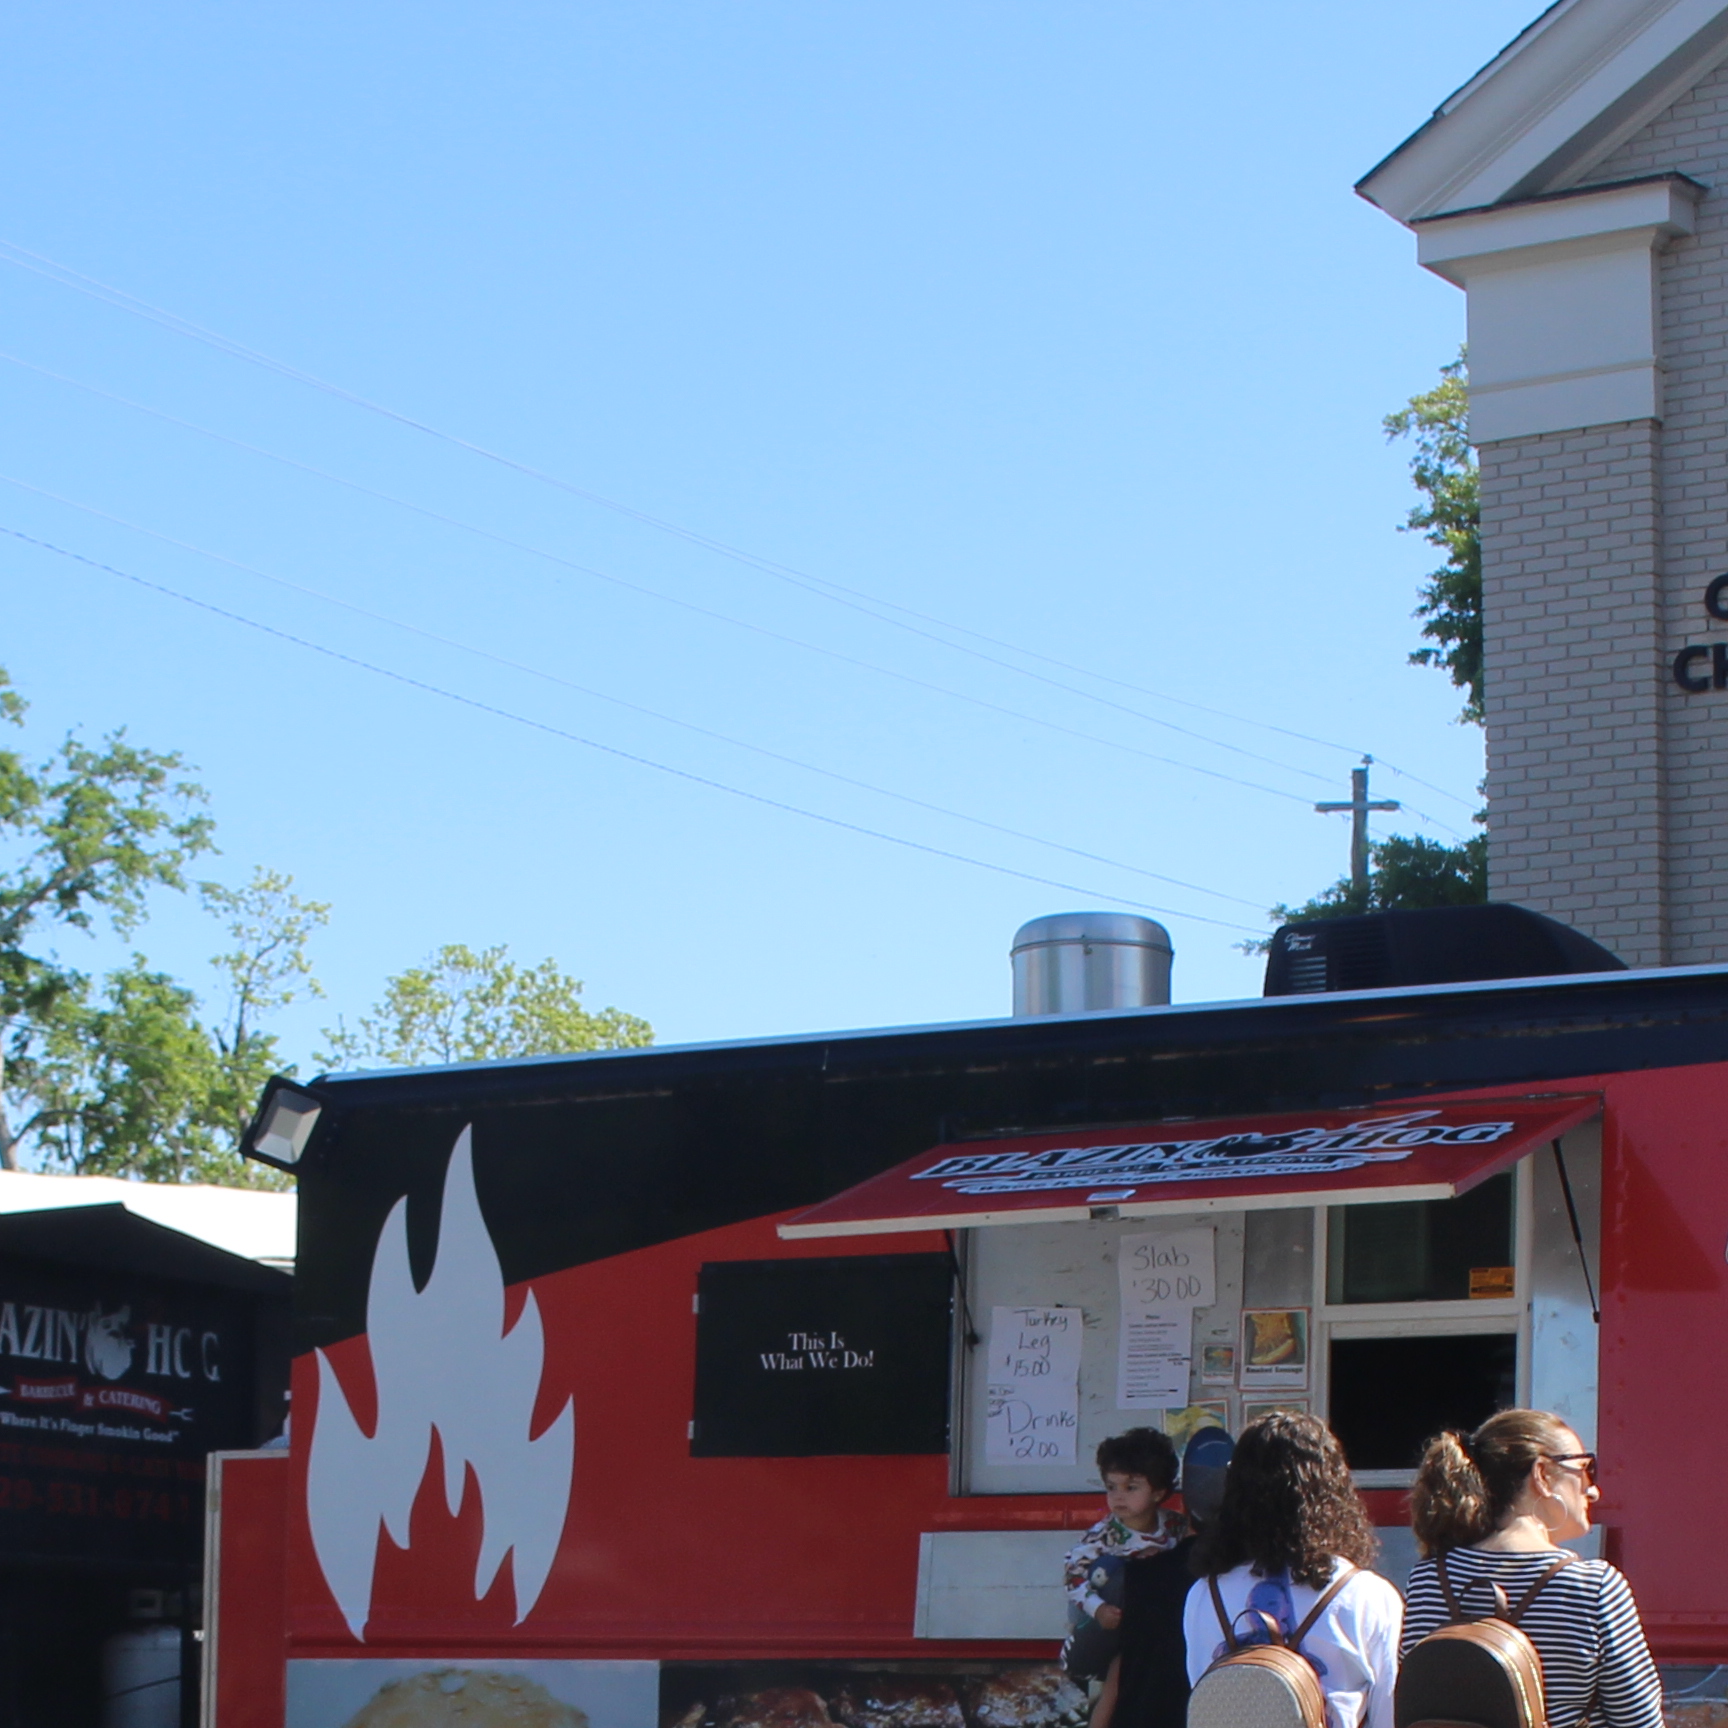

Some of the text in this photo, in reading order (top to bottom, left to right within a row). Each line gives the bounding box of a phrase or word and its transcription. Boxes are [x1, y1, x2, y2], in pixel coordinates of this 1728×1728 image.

[1132, 1245, 1190, 1271] Slab
[1013, 1309, 1068, 1332] Turkey
[787, 1331, 845, 1351] This Is
[1018, 1332, 1051, 1358] Leg
[760, 1350, 874, 1370] What We Do!
[20, 1383, 161, 1415] BARBECUE & CATERING
[1000, 1399, 1076, 1435] Drinks
